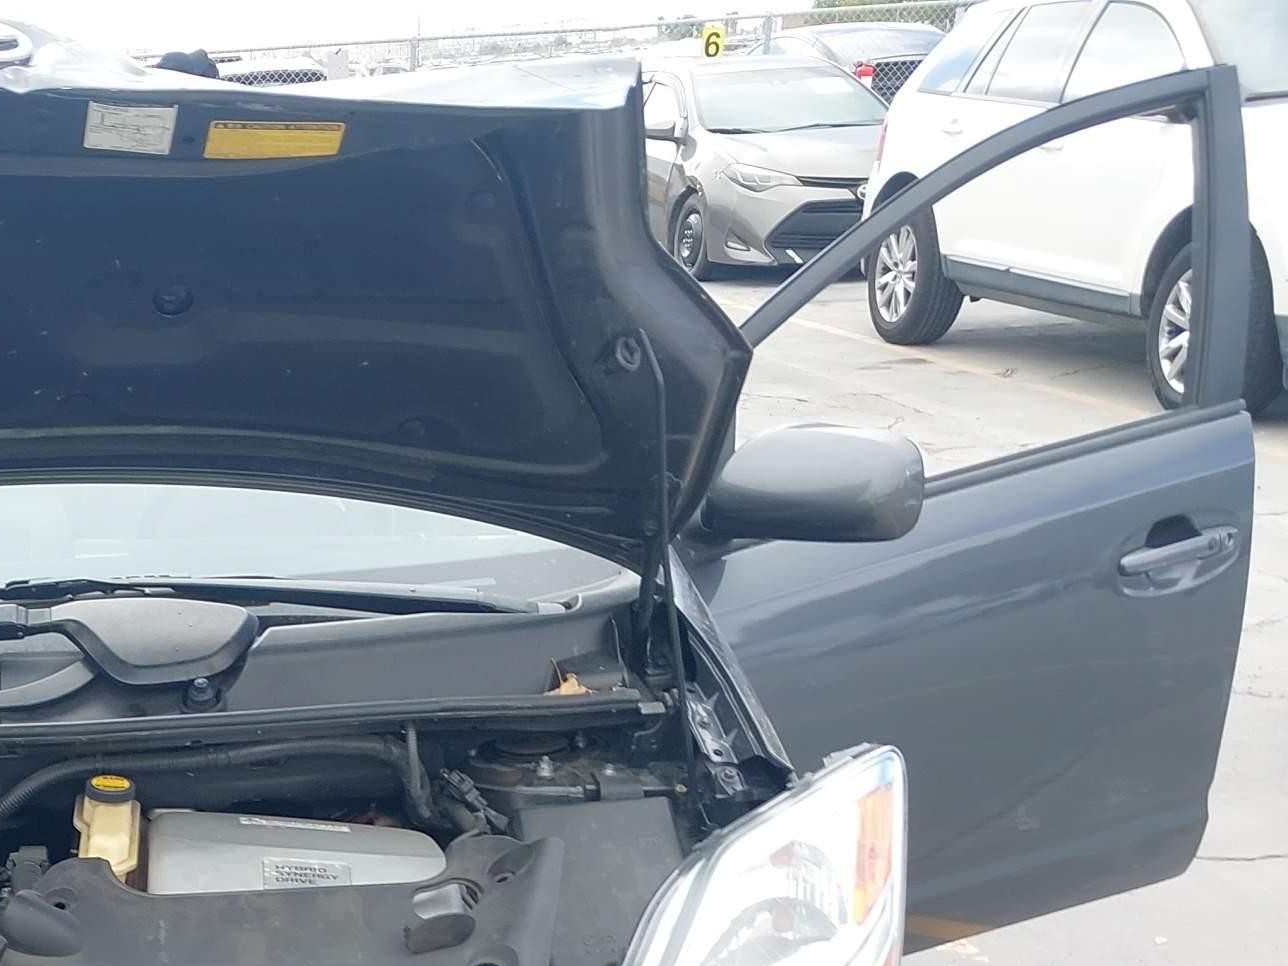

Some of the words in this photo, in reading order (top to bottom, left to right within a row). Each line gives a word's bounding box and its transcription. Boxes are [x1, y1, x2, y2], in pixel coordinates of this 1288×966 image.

[704, 31, 720, 57] 6
[275, 865, 327, 873] HYBRID
[275, 870, 338, 880] SYNERGY
